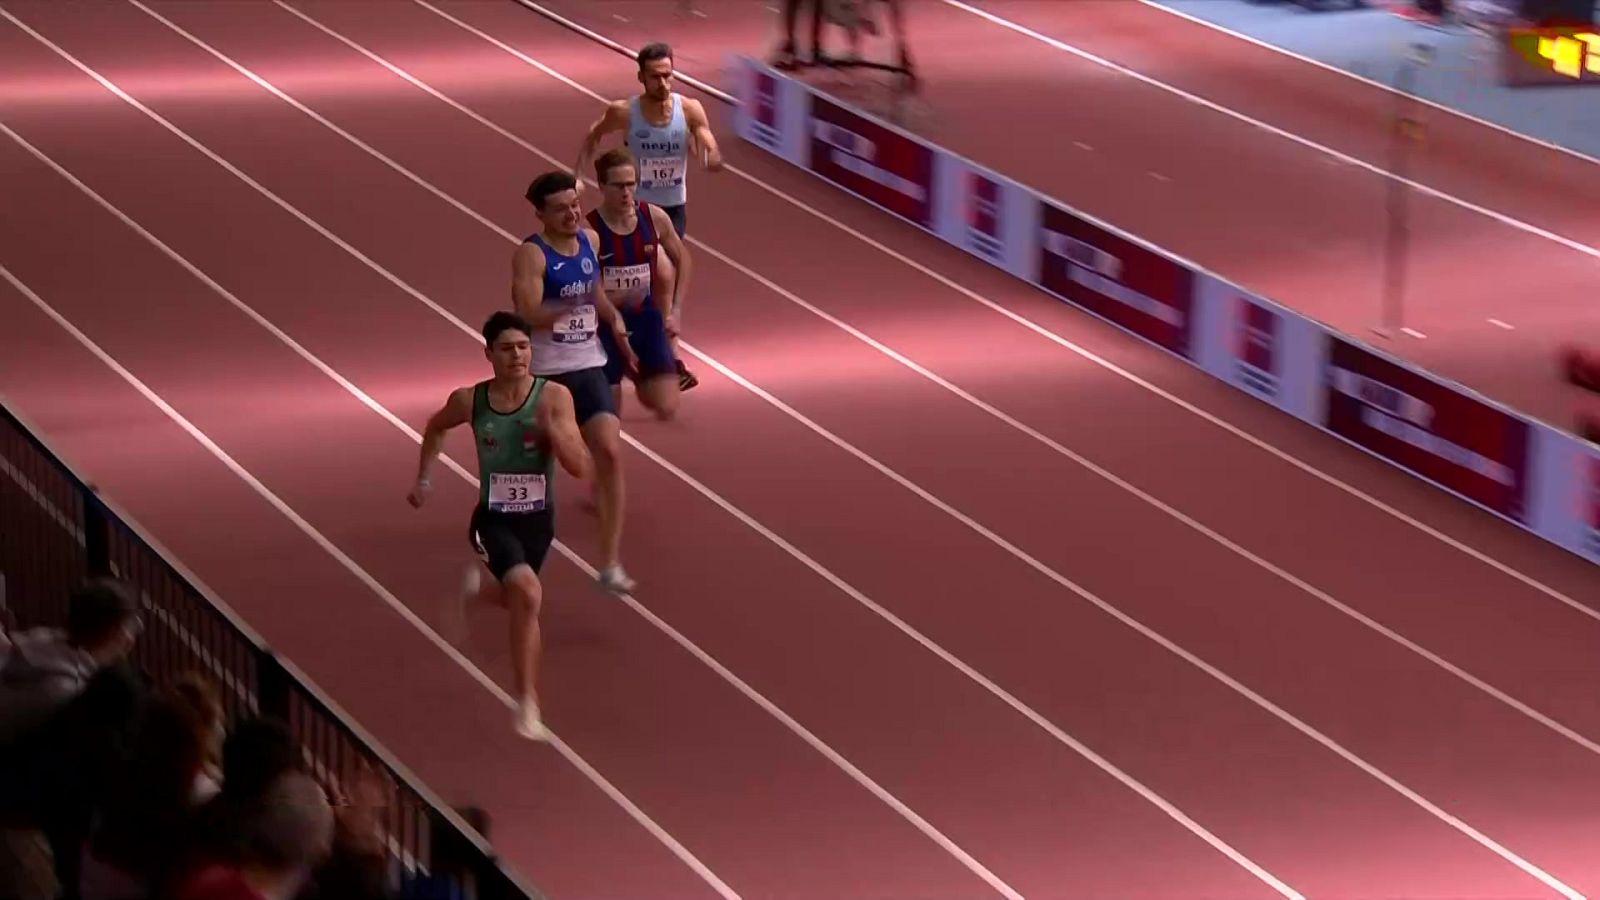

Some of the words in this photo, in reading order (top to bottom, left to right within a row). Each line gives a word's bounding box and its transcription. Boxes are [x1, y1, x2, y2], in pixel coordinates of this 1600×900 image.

[641, 141, 680, 153] nerja
[652, 168, 674, 179] 167
[569, 318, 584, 330] 84
[508, 487, 528, 501] 33
